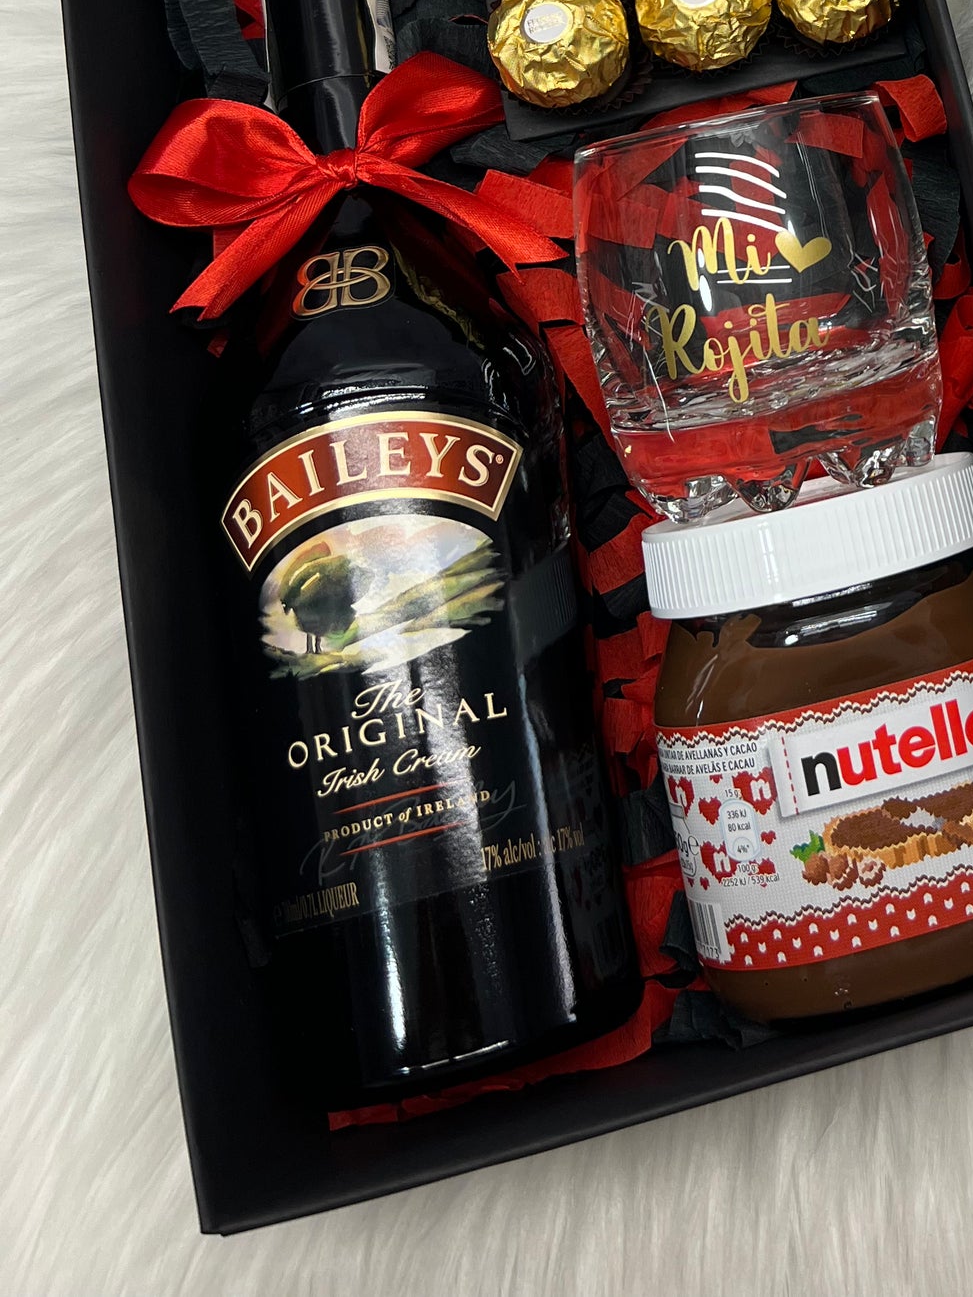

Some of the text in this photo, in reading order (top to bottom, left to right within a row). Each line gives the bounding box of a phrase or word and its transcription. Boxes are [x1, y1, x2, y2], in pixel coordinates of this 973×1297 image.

[667, 217, 772, 291] Mi
[645, 292, 830, 404] Rojita
[352, 680, 426, 719] The
[287, 692, 508, 769] ORIGINAL
[685, 746, 723, 761] AVELLANAS
[722, 746, 728, 756] Y
[729, 742, 757, 756] CACAO
[317, 743, 482, 797] Irish Cream
[695, 760, 721, 775] AVELÃS
[721, 762, 728, 772] E
[728, 757, 755, 771] CACAU
[724, 789, 733, 797] 15
[324, 789, 491, 843] PRODUCT of IRELAND
[727, 809, 747, 819] 336 kJ
[728, 822, 751, 833] 80 kcal
[481, 843, 502, 871] 17%
[737, 864, 750, 874] 100
[723, 878, 738, 888] 2252
[739, 876, 747, 886] kJ
[751, 875, 765, 885] 539
[765, 873, 780, 884] kcal
[316, 882, 360, 919] LIQUEUR
